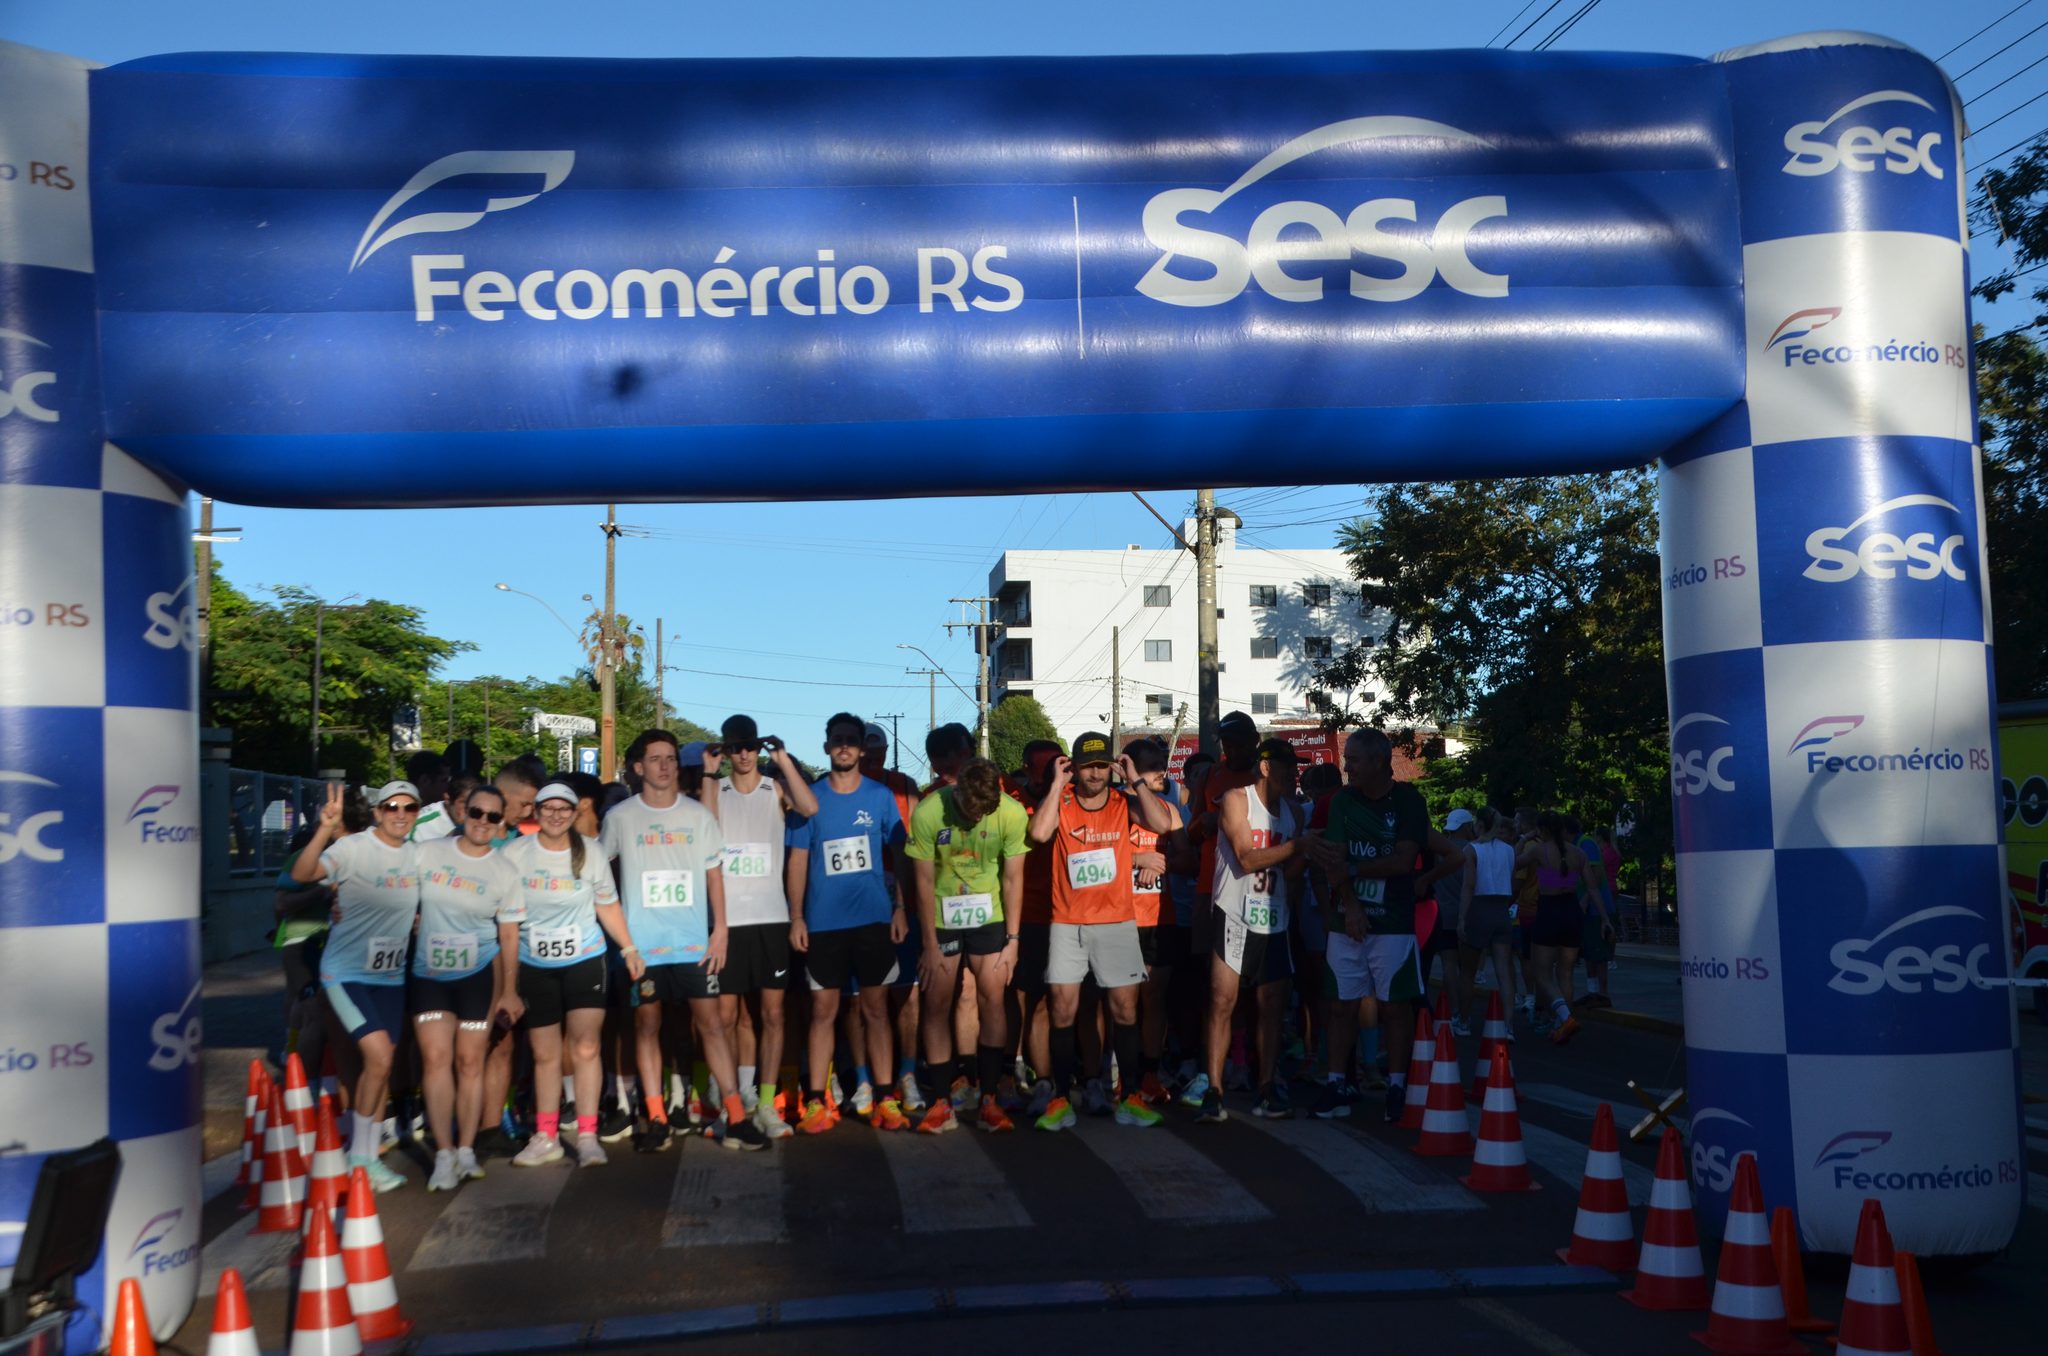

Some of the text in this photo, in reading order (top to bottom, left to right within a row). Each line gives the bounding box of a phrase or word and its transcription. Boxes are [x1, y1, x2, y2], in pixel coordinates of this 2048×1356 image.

[30, 161, 75, 190] RS
[1134, 187, 1509, 307] Sesc
[411, 245, 1024, 321] Fecomércio RS
[1945, 345, 1965, 368] RS
[1802, 526, 1966, 583] Sesc
[1714, 555, 1746, 579] RS
[46, 603, 89, 627] RS
[1807, 748, 1989, 773] Fecomércio RS
[729, 856, 765, 875] 488
[832, 850, 865, 871] 616
[1076, 862, 1112, 884] 494
[649, 883, 686, 903] 516
[951, 907, 987, 926] 479
[1249, 907, 1278, 927] 536
[432, 947, 469, 967] 551
[538, 939, 575, 957] 855
[1736, 957, 1769, 980] RS
[0, 1042, 93, 1072] io RS
[1834, 1160, 2017, 1190] Fecomércio RS
